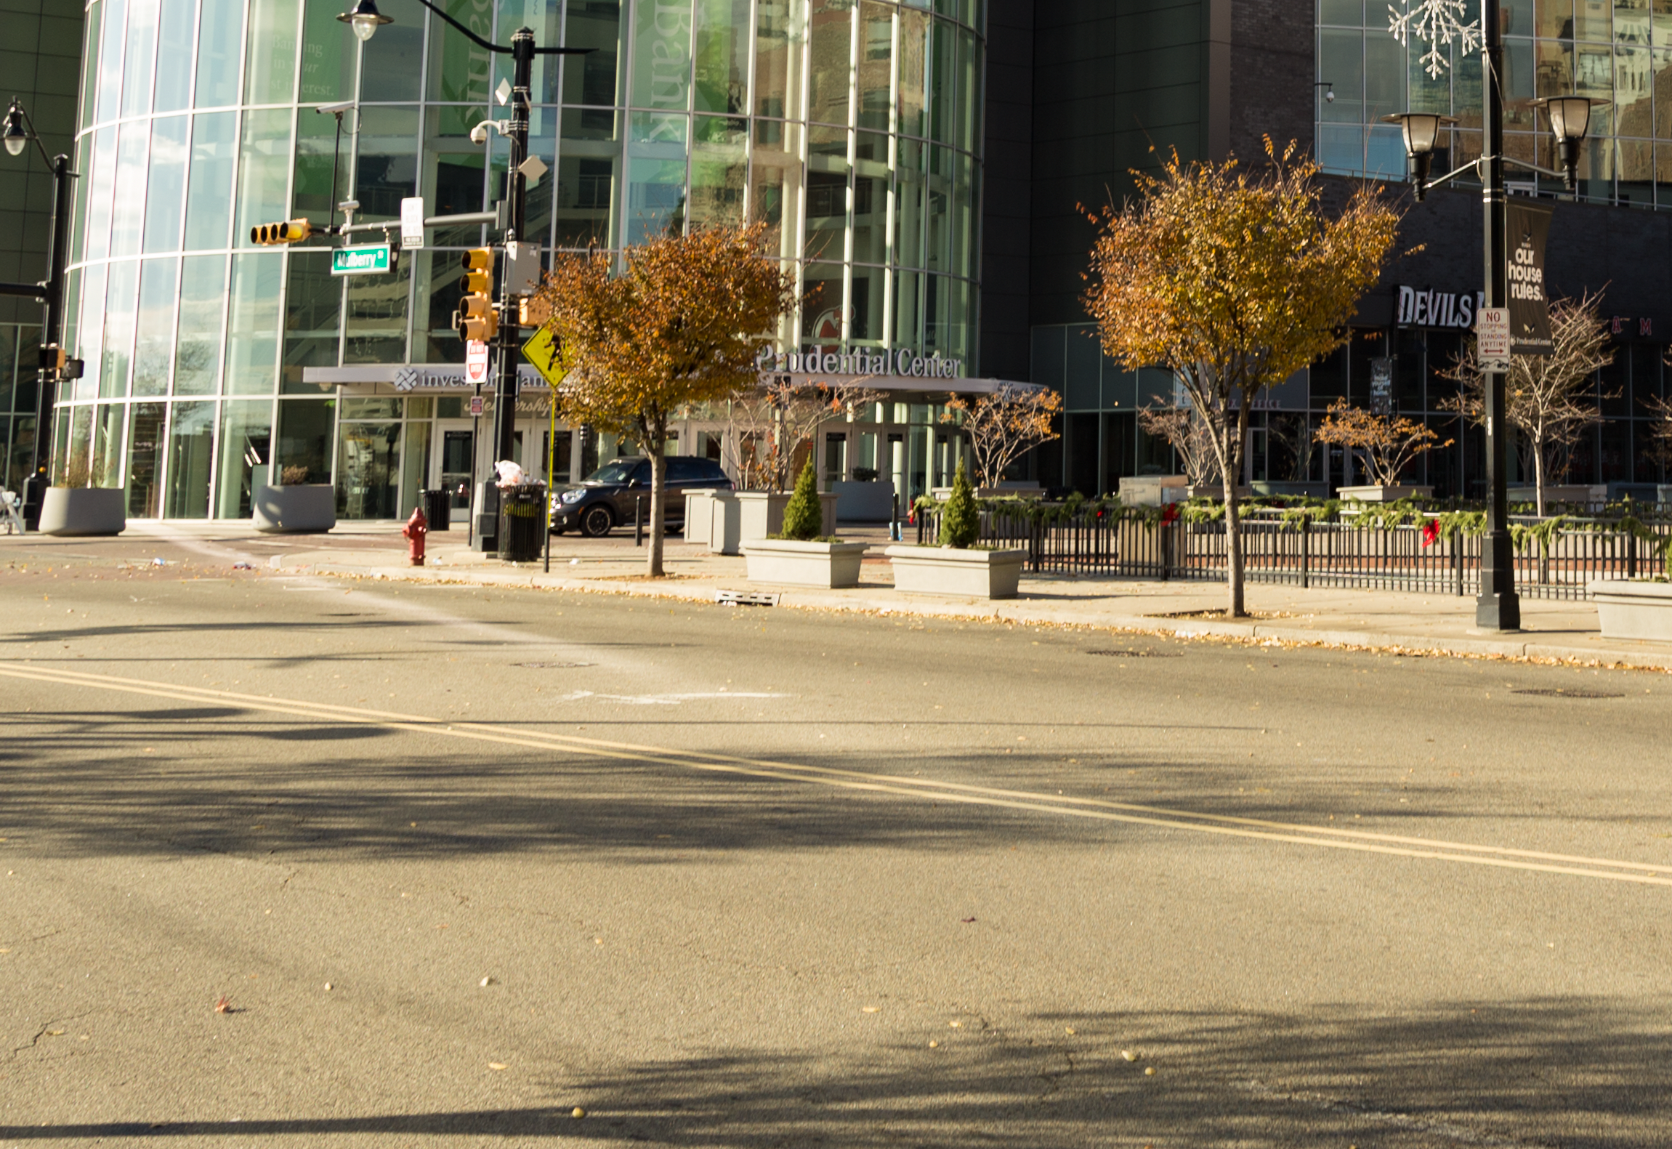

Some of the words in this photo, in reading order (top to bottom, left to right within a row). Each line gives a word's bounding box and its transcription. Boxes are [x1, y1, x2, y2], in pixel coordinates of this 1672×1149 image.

[272, 34, 323, 57] Baning
[337, 252, 376, 269] Mulberry
[1515, 248, 1534, 265] our
[1508, 260, 1542, 283] house
[1511, 281, 1543, 301] rules.
[1397, 286, 1472, 328] DEVILS
[1480, 322, 1507, 330] STOPPING
[1486, 311, 1501, 323] NO
[756, 344, 892, 376] Prudential
[897, 348, 961, 378] Center
[1251, 399, 1281, 409] FFICE
